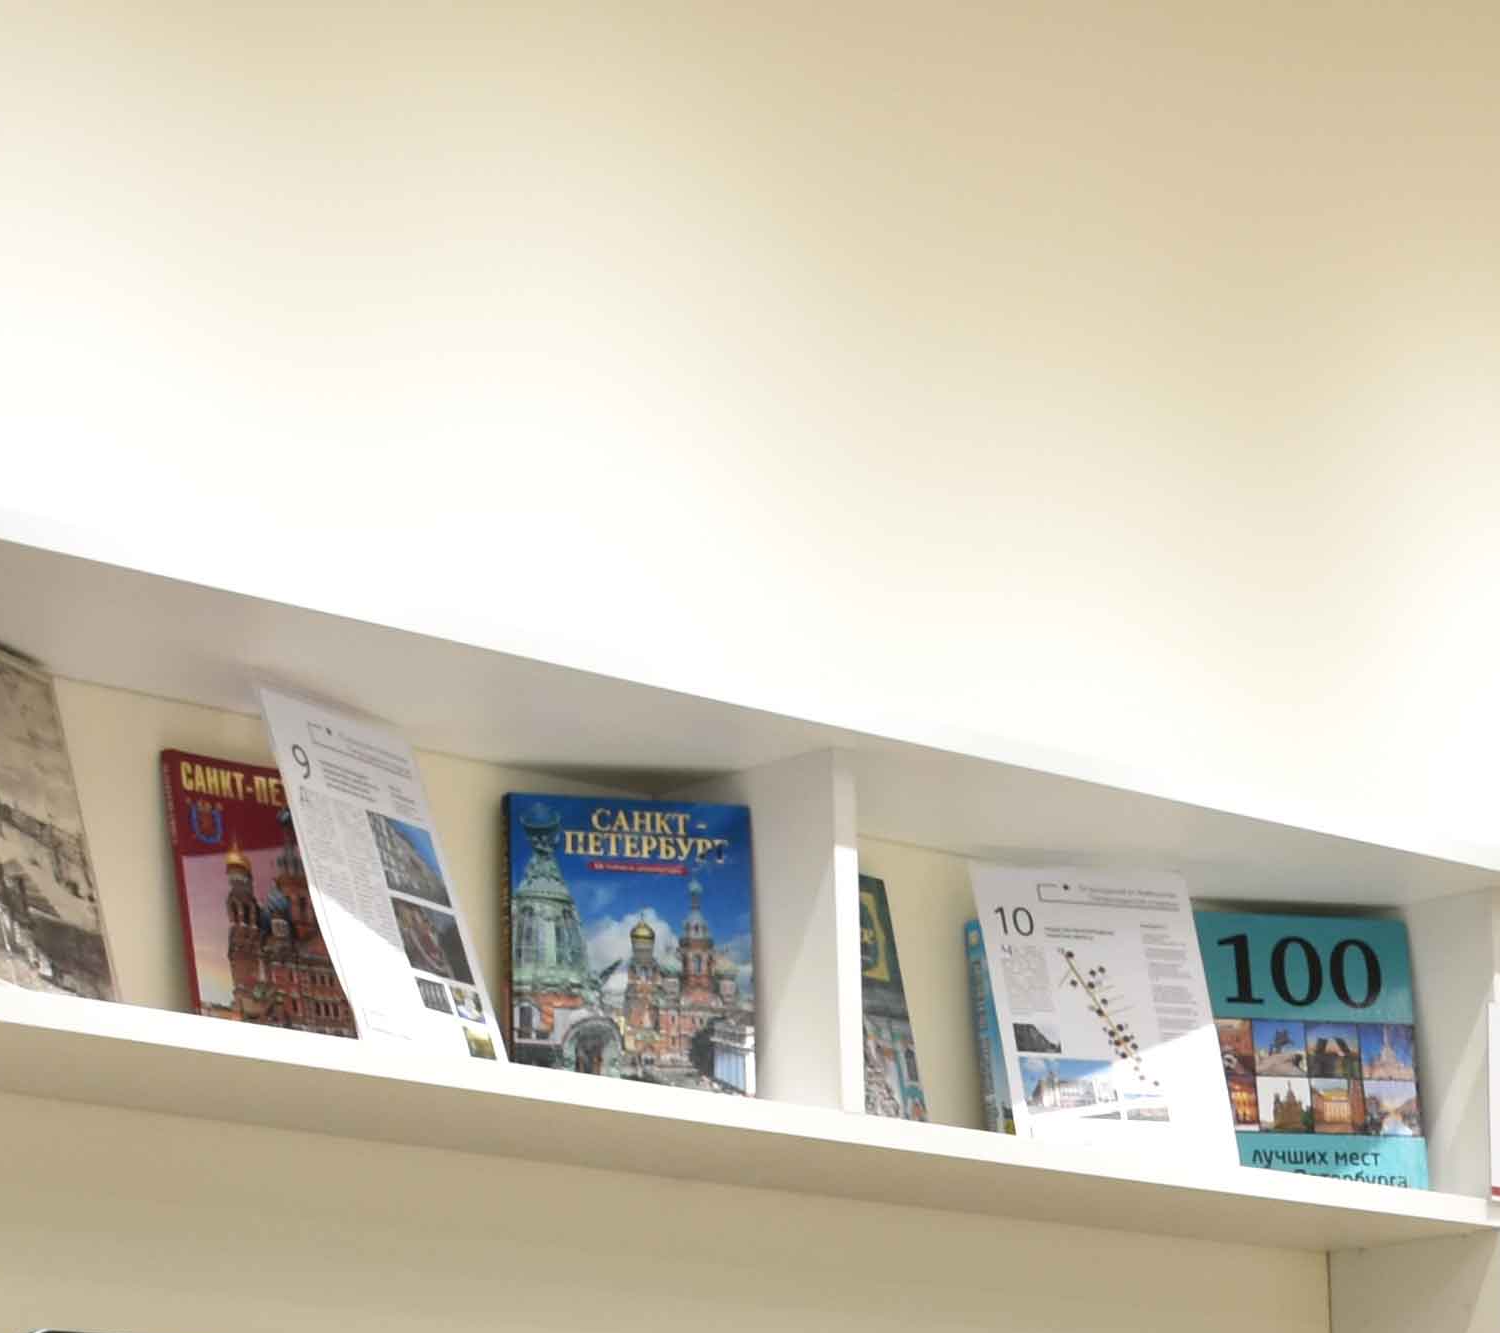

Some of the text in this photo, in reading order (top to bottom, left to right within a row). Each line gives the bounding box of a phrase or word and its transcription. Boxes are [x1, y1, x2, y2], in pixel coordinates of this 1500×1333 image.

[291, 743, 312, 781] 9
[564, 831, 729, 864] ПЕТЕРБУРГ
[994, 906, 1034, 936] 10
[1217, 933, 1383, 1009] 100
[1252, 1149, 1380, 1168] лучших мест
